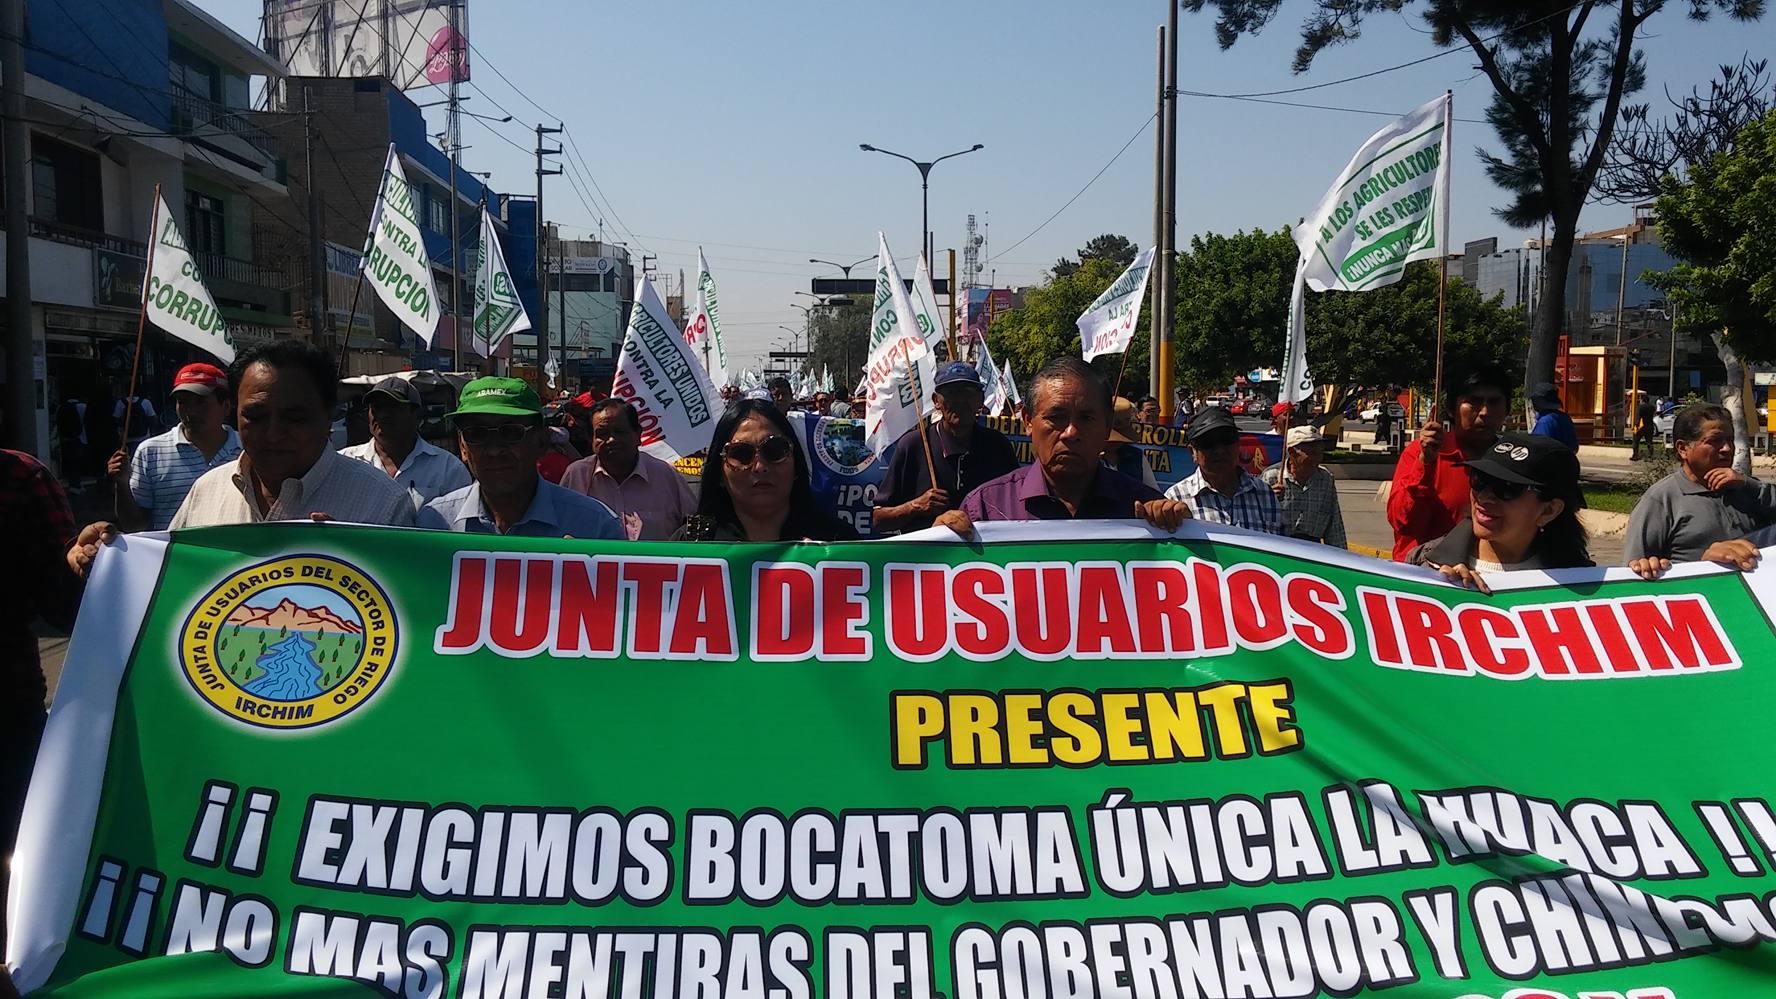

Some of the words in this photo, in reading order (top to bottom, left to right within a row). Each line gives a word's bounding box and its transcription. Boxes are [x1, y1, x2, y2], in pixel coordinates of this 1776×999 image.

[1328, 200, 1354, 232] LOS
[1354, 220, 1374, 241] SE
[1369, 207, 1395, 231] LES
[367, 240, 430, 323] RUPCIÓN
[148, 276, 235, 347] CORRUPC
[653, 389, 674, 410] LA
[673, 373, 708, 426] UNIDOS
[206, 566, 295, 617] USUARIOS
[301, 565, 334, 581] DEL
[338, 574, 386, 631] SECTOR
[434, 551, 739, 662] JUNTA
[749, 560, 873, 662] DE
[884, 558, 1356, 662] USUARIOS
[1356, 594, 1742, 680] IRCHIM
[194, 619, 213, 640] DE
[370, 636, 387, 658] DE
[193, 645, 225, 691] JUNTA
[333, 660, 380, 705] RIEGO
[234, 696, 315, 721] IRCHIM
[892, 680, 1301, 769] PRESENTE
[293, 797, 673, 904] EXIGIMOS
[685, 809, 1088, 904] BOCATOMA
[1089, 790, 1332, 896] ÚNICA
[1323, 780, 1437, 873] LA
[1413, 788, 1707, 880] HUACA
[286, 909, 452, 999] MAS
[457, 926, 812, 999] MENTIRAS
[823, 927, 944, 999] DEL
[952, 900, 1416, 999] GOBERNADOR
[1405, 890, 1467, 980] Y
